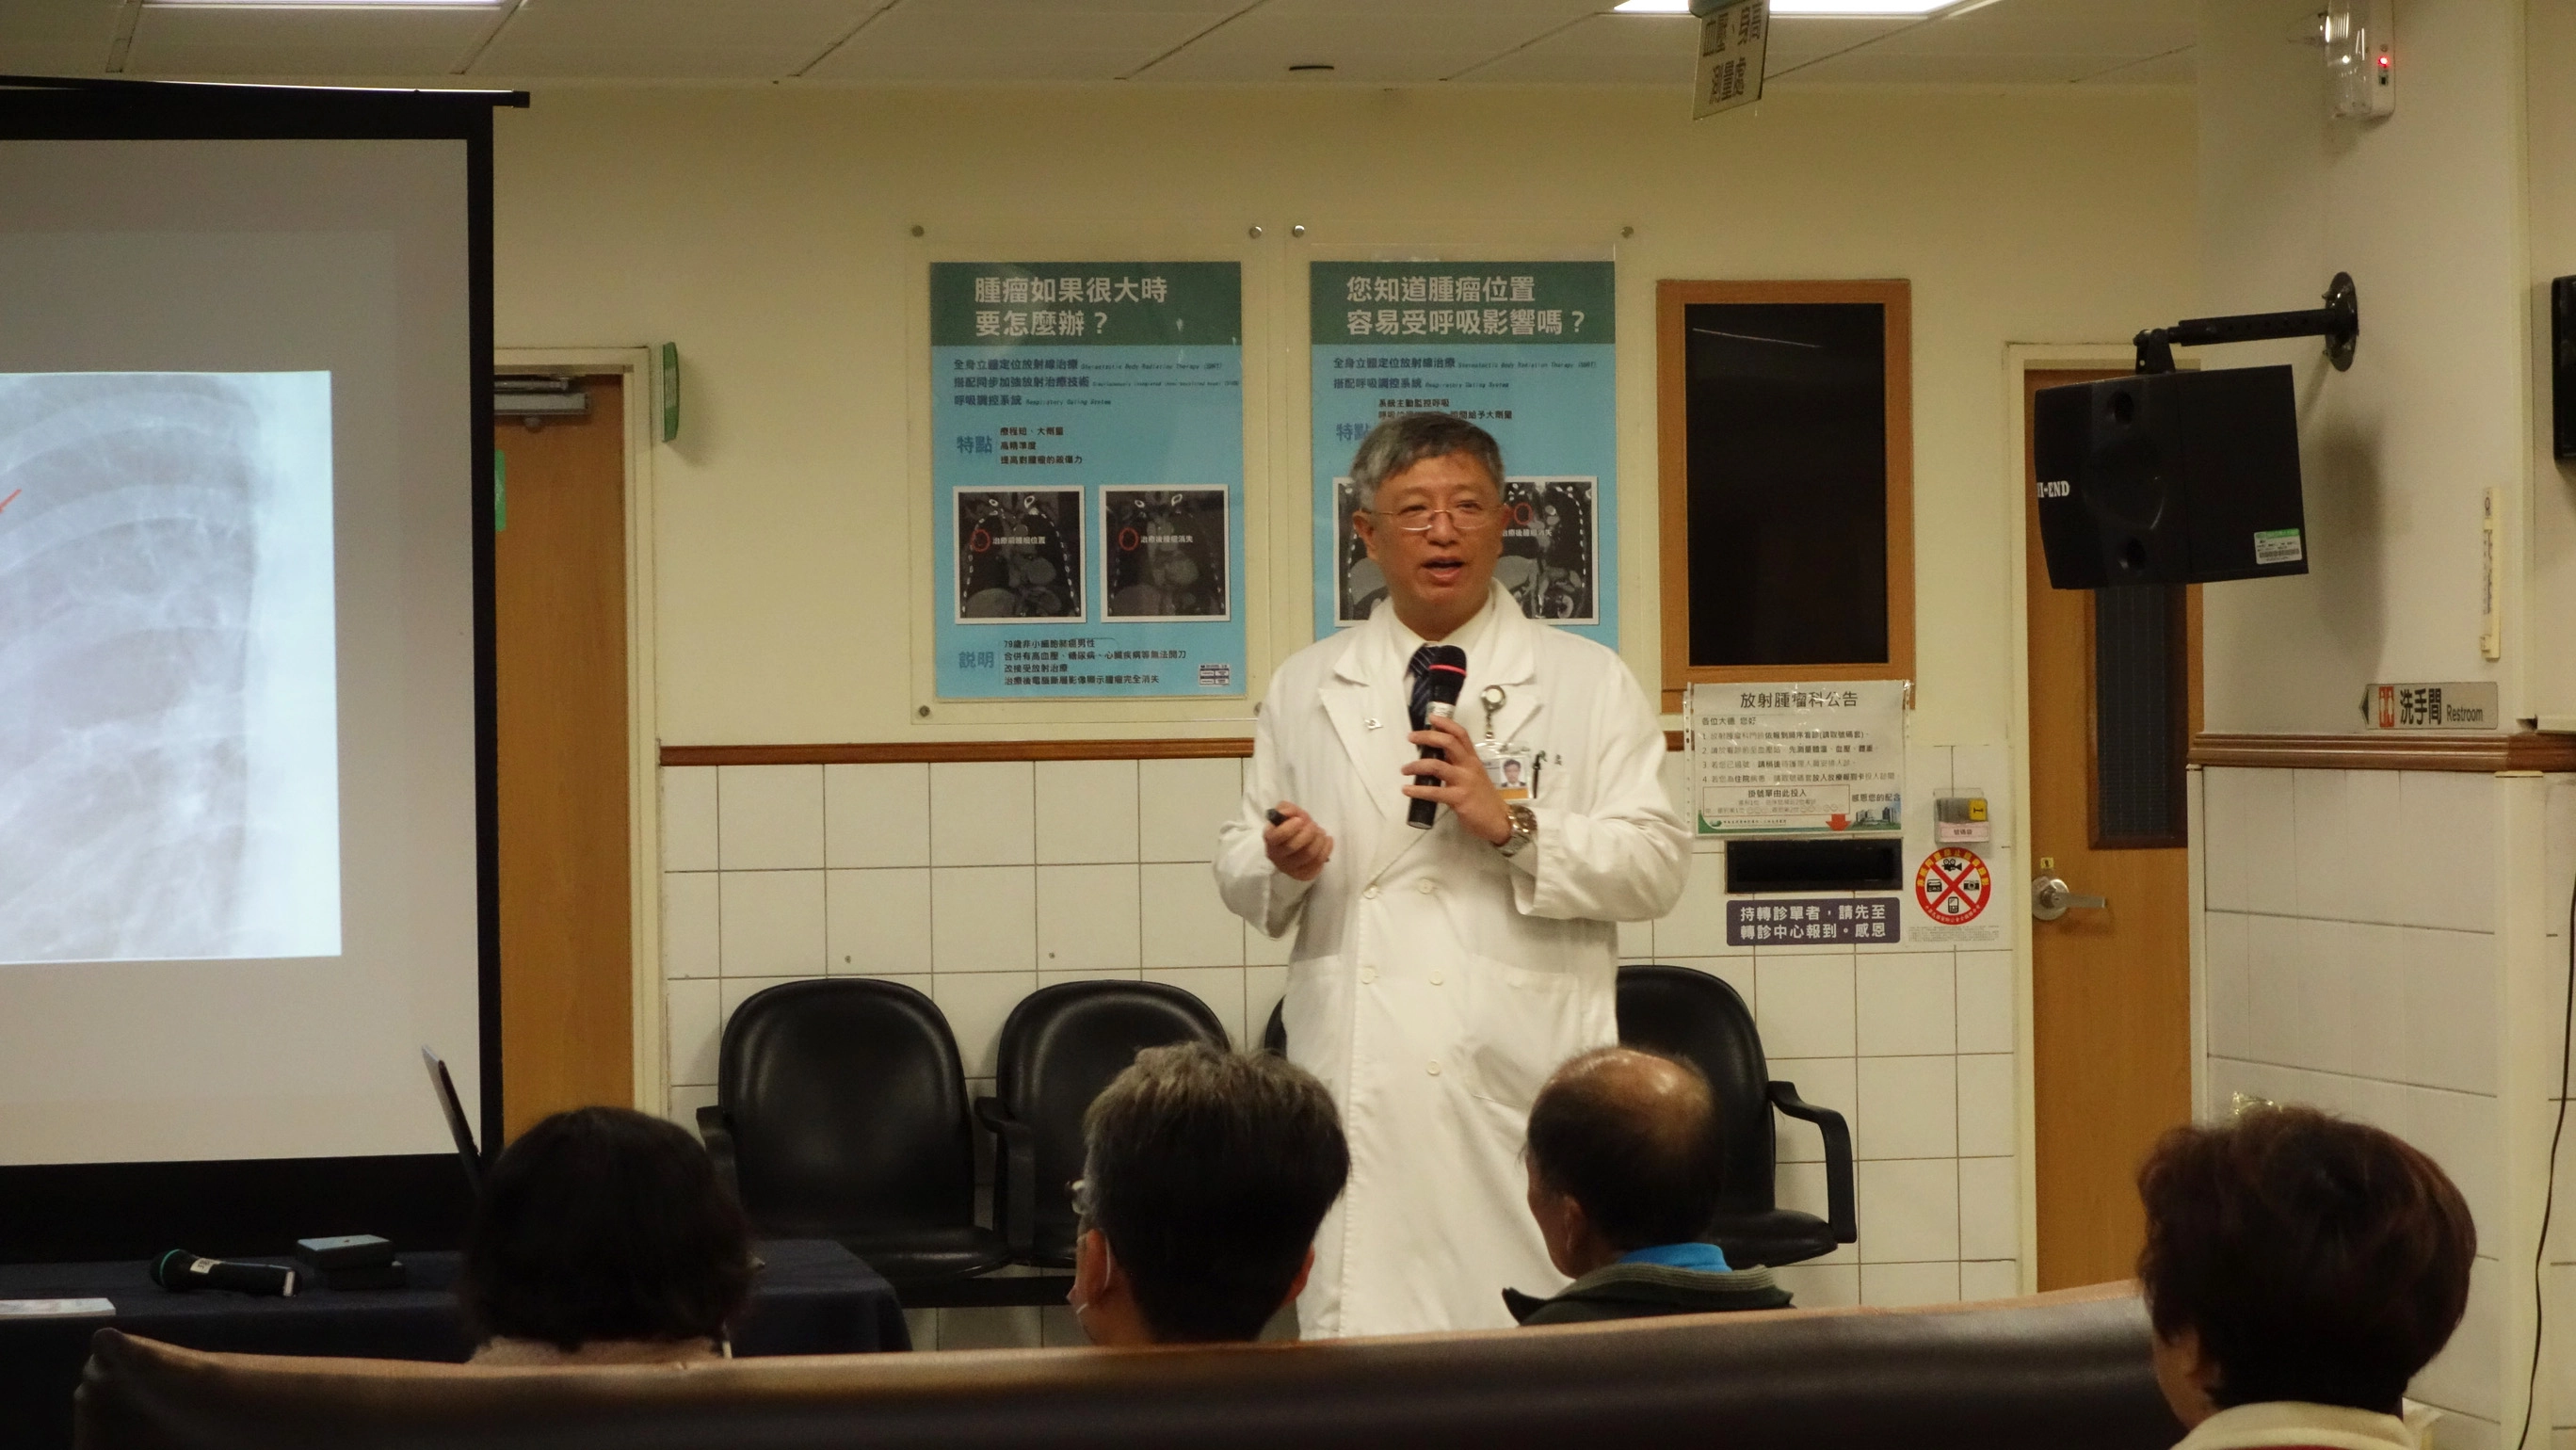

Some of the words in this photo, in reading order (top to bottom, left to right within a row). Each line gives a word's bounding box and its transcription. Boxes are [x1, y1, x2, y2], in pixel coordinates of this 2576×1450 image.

[974, 277, 1167, 304] 腫瘤如果很大時
[1346, 276, 1535, 302] 您知道腫瘤位置
[975, 310, 1107, 336] 要怎麼辦？
[1346, 309, 1585, 335] 容易受呼吸影響嗎？
[954, 359, 1078, 370] 全身立體定位放射線治療
[1333, 357, 1456, 369] 全身立體定位放射線治療
[954, 395, 1022, 406] 呼吸調控系統
[957, 435, 992, 454] 特點
[1740, 692, 1858, 708] 放射腫瘤科公告
[2400, 687, 2441, 725] 洗手間
[2447, 704, 2483, 722] Restroom
[1748, 789, 1807, 798] 掛號單由此投入
[1852, 793, 1901, 802] 感恩您的配合
[1740, 904, 1886, 922] 持轉診單者，請先至
[1740, 922, 1886, 940] 轉診中心報到。感恩
